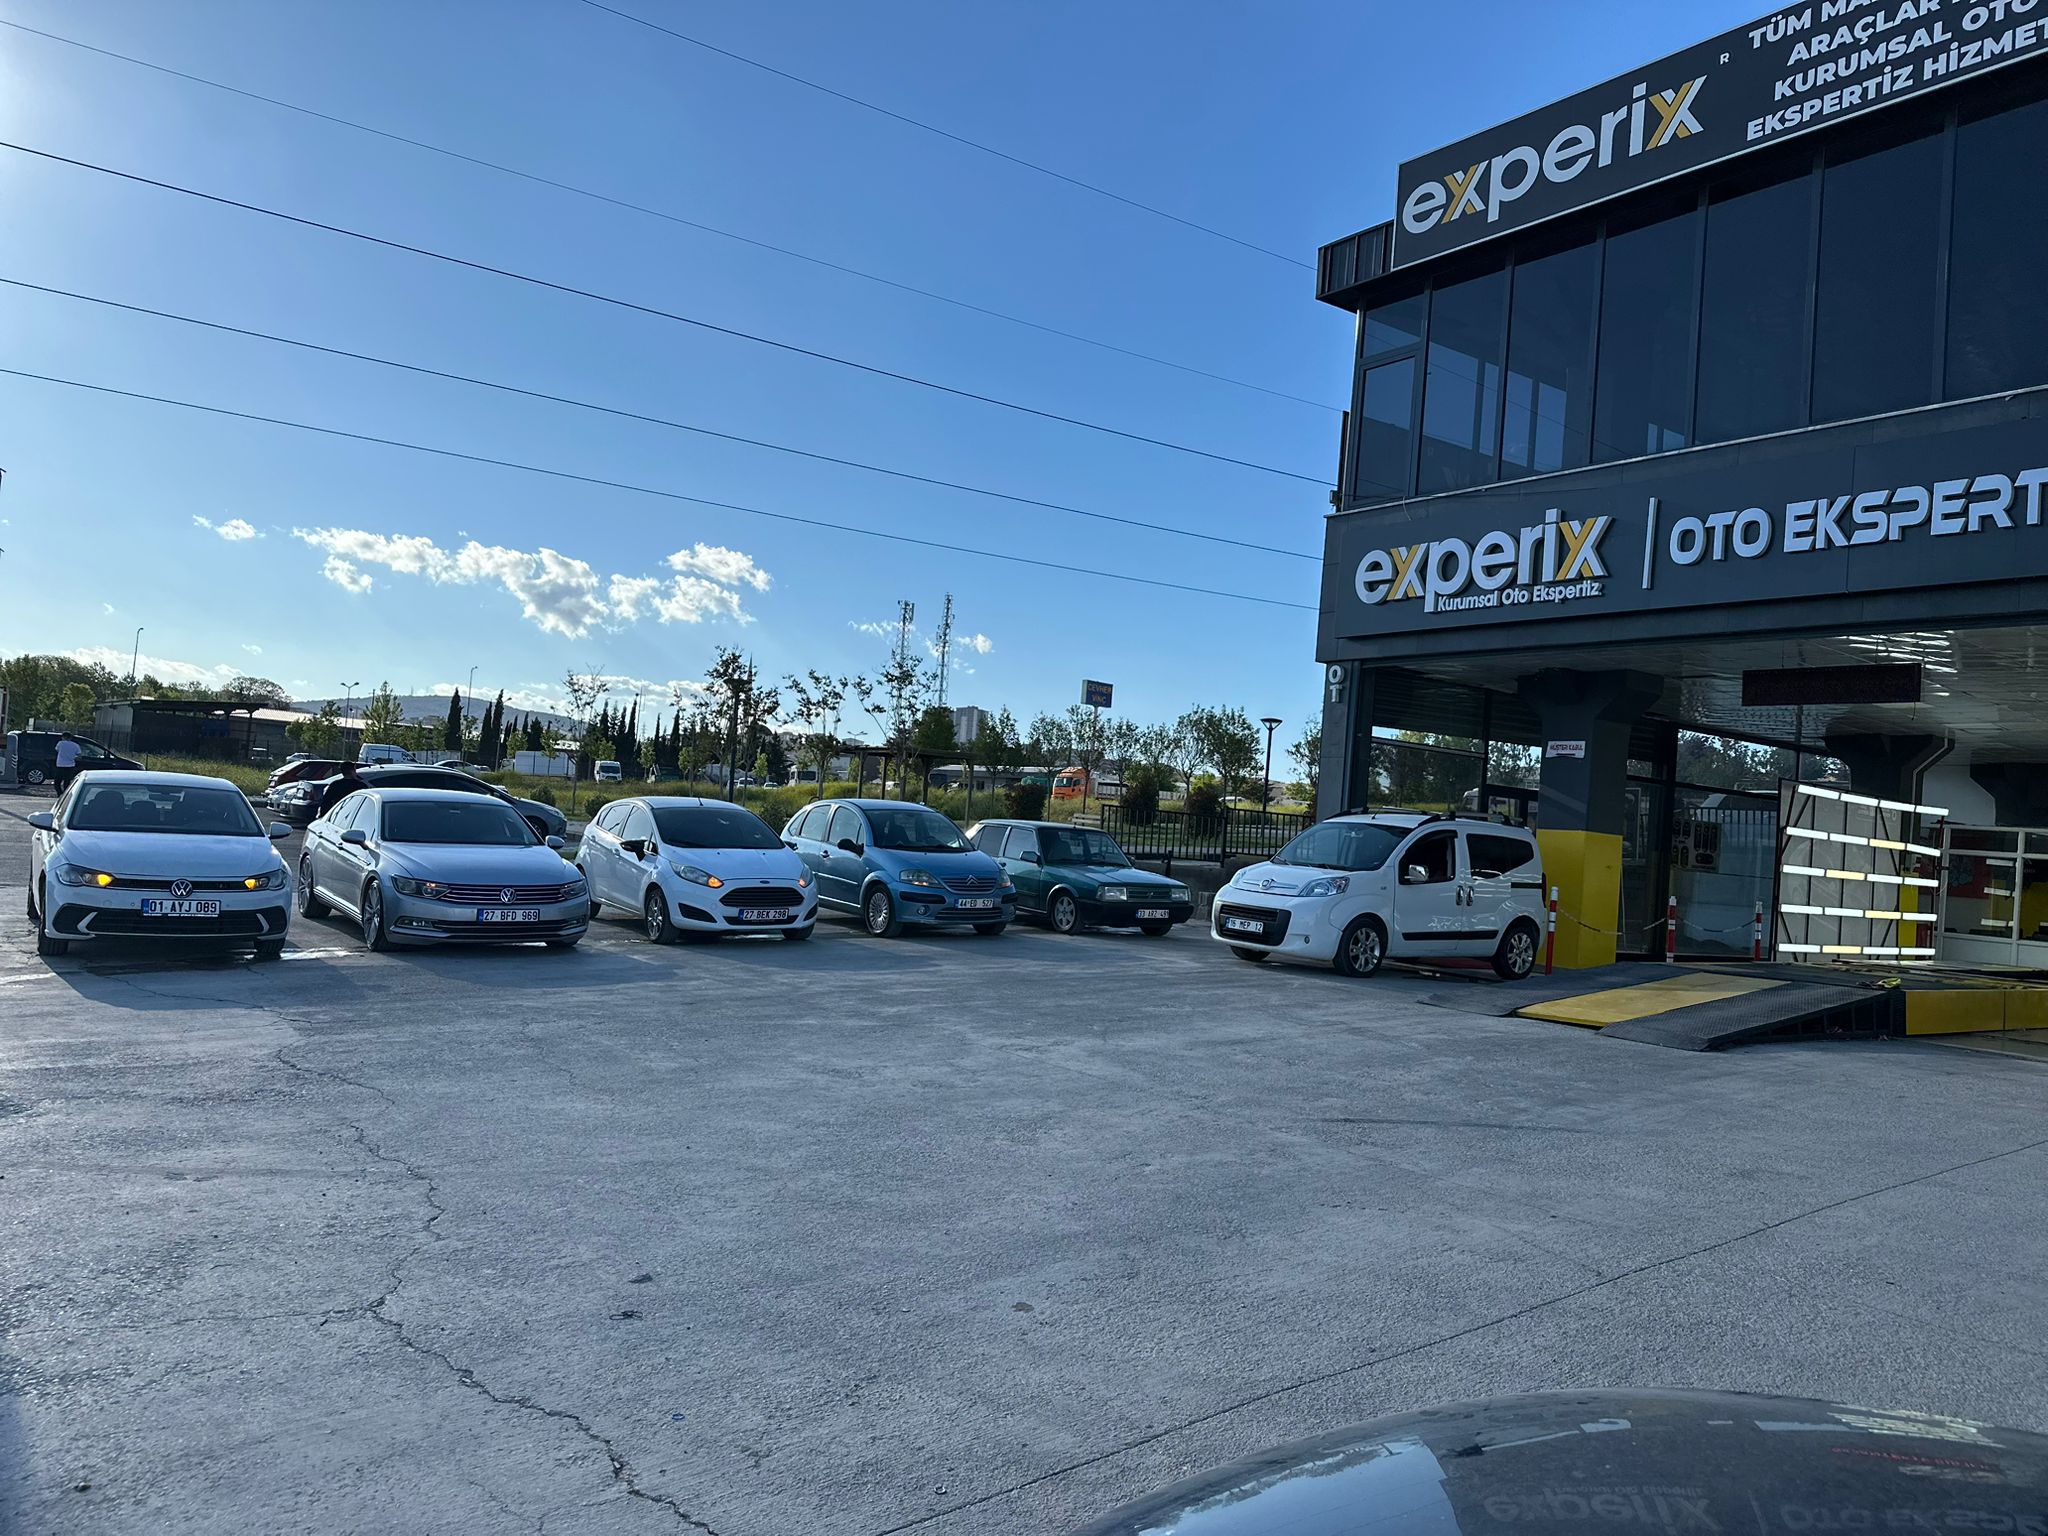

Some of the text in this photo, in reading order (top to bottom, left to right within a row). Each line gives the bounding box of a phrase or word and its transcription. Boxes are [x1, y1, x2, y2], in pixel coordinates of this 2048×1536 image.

[1749, 8, 1812, 49] TÜM
[1787, 0, 1941, 66] ARAÇLAR
[1774, 21, 1952, 101] KURUMSAL
[1747, 66, 1914, 141] EKSPERTİZ
[1402, 75, 1708, 234] experix
[1355, 508, 1612, 613] experix
[1669, 507, 1772, 566] OTO
[1437, 581, 1601, 612] Kurumsal Oto Ekspertiz
[150, 901, 217, 913] 01 AYJ 089
[484, 910, 538, 921] 27 BFD 969
[744, 910, 786, 919] 27 BEK 298
[1255, 922, 1263, 932] 12
